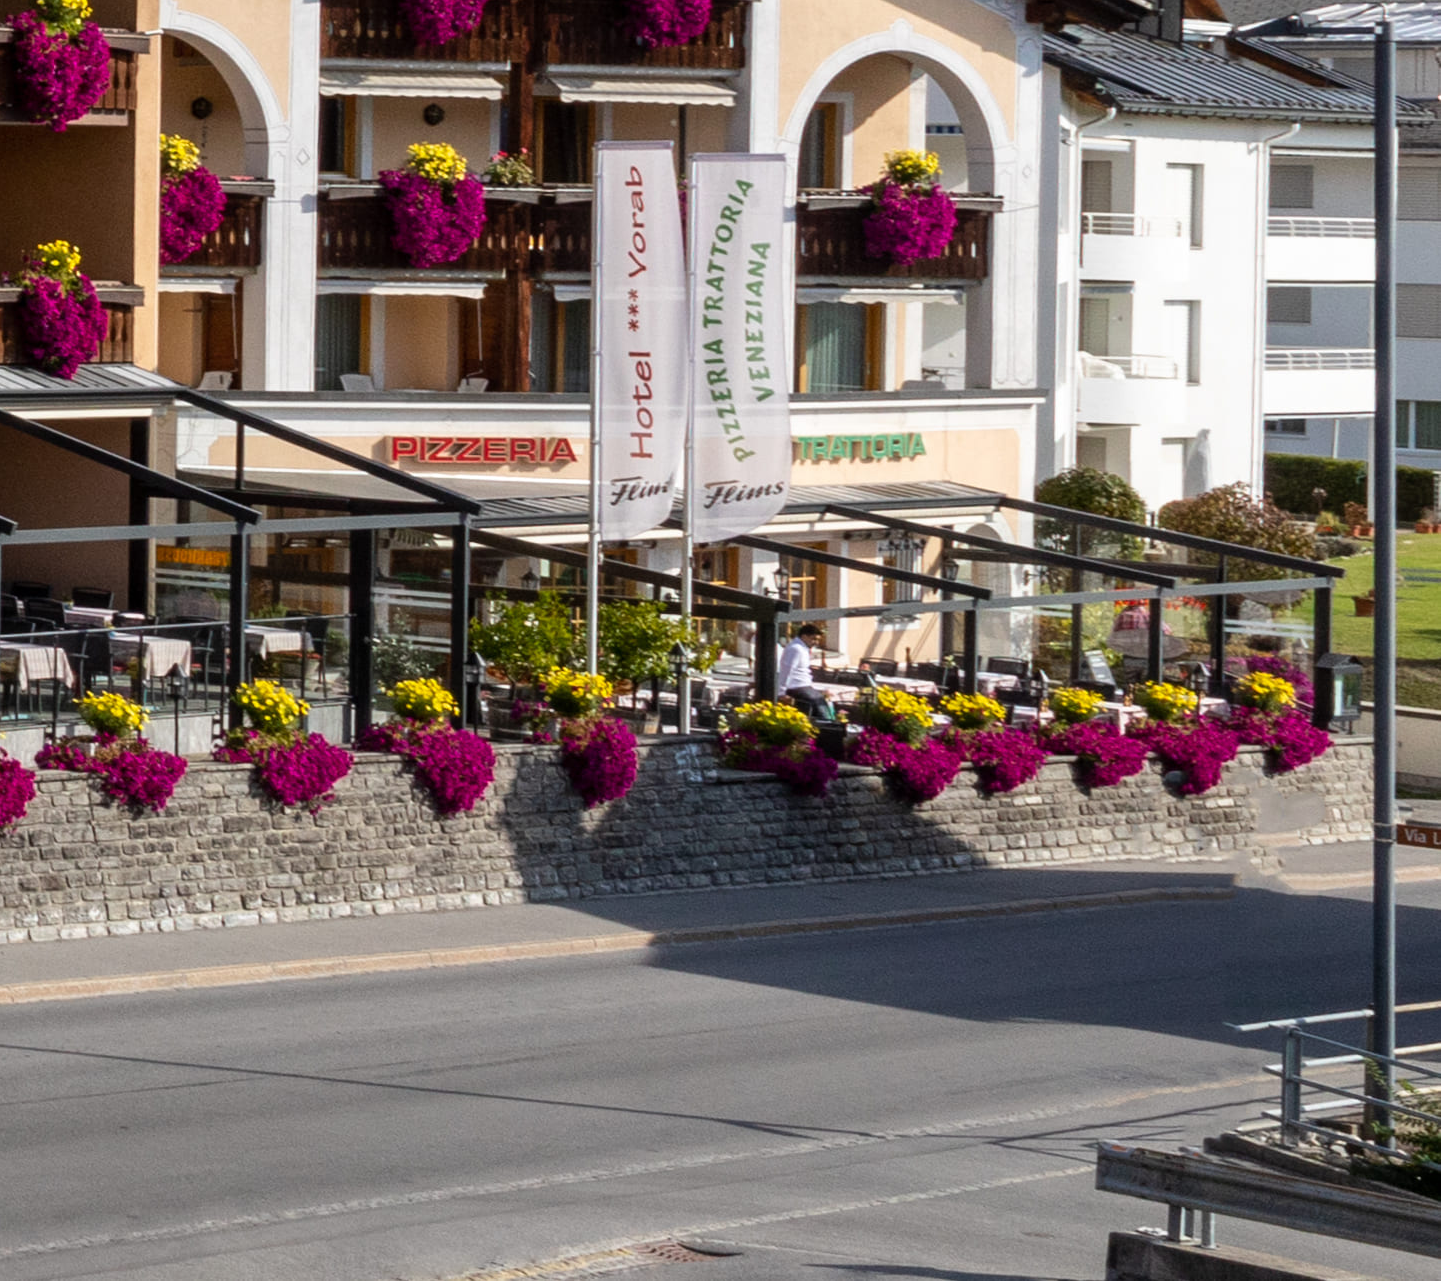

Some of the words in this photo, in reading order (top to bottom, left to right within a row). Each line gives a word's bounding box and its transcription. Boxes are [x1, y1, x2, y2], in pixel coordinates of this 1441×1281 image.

[624, 165, 647, 278] Vorab
[702, 179, 754, 329] TRATTORIA
[745, 242, 775, 402] VENEZIANA
[391, 437, 578, 463] PIZZERIA
[629, 350, 654, 460] Hotel
[702, 338, 756, 462] PIZZERIA
[797, 432, 927, 460] TRATTORIA
[704, 479, 785, 510] Flims
